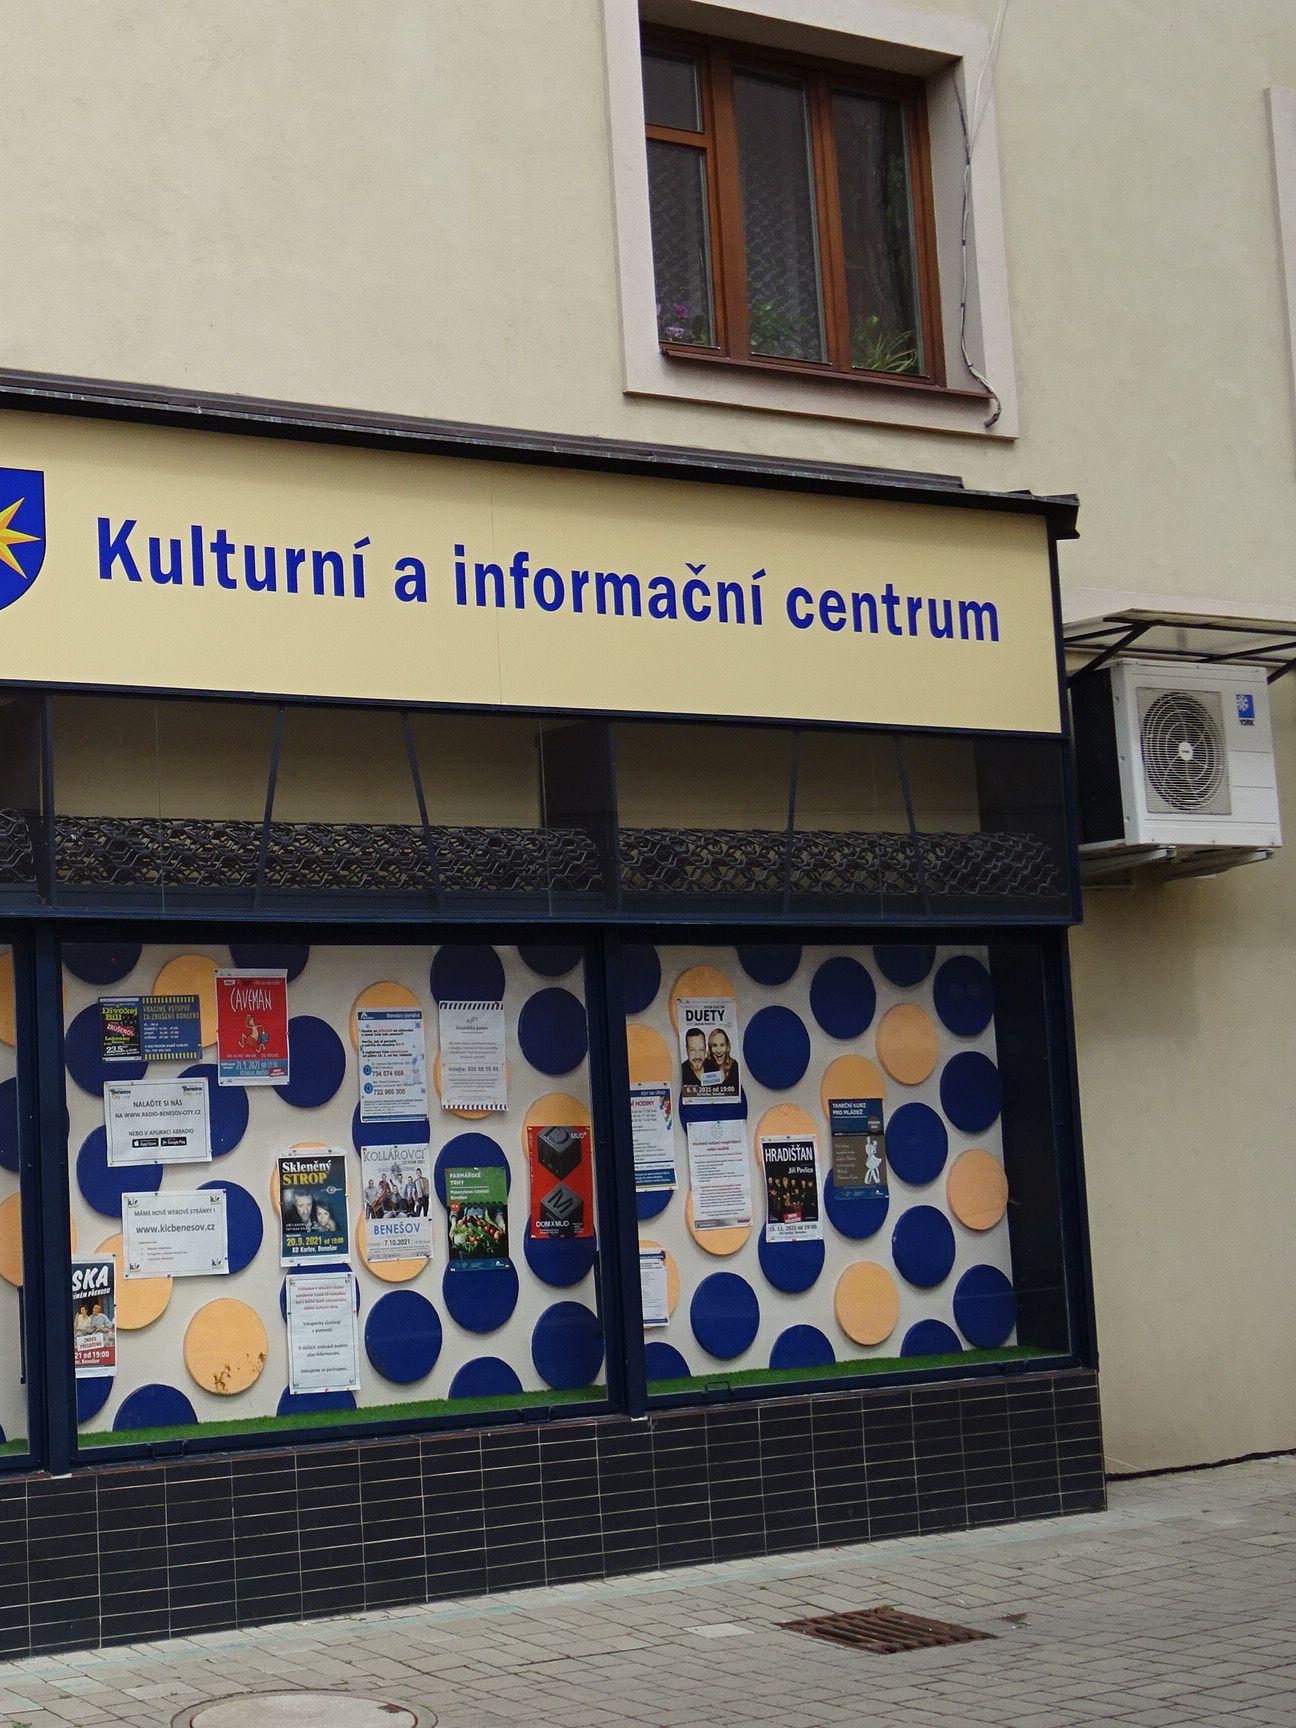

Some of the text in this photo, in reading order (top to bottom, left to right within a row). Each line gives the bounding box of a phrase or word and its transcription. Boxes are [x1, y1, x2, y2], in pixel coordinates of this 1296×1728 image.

[97, 516, 1001, 642] Kulturní a informační centrum
[230, 987, 272, 1013] CAVEMAN
[685, 1009, 725, 1022] DUETY
[363, 1148, 425, 1162] KOLLÁROVCI
[764, 1144, 813, 1162] HRADIŠŤAN
[282, 1159, 332, 1173] Skleněný
[796, 1166, 814, 1174] Pavlica
[282, 1171, 327, 1186] STROP
[136, 1222, 215, 1234] www.kicbenesov.cz
[373, 1222, 421, 1236] BENEŠOV
[83, 1351, 92, 1359] od
